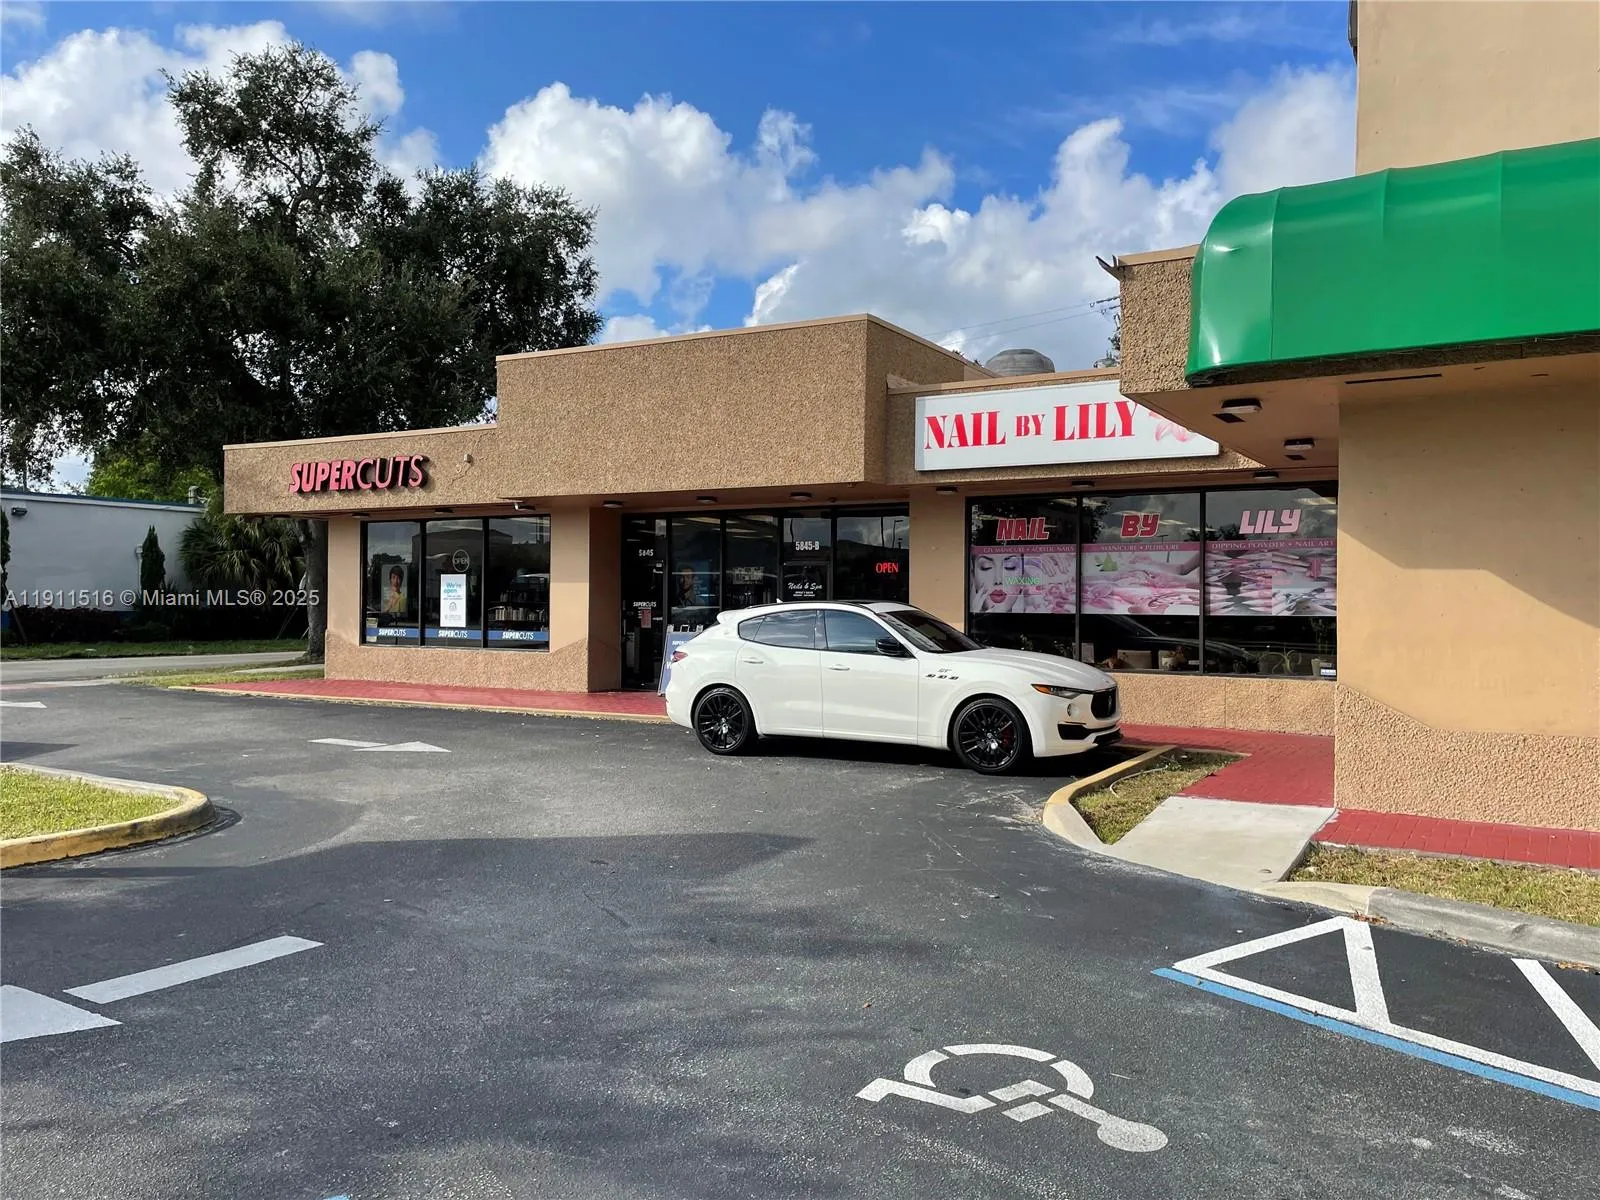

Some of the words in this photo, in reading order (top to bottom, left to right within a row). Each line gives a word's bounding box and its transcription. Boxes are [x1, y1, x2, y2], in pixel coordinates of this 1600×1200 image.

[925, 410, 1006, 450] NAIL
[1015, 414, 1045, 437] BY
[1053, 400, 1138, 442] LILY
[288, 454, 423, 493] SUPERCUTS
[996, 517, 1049, 541] NAIL
[1121, 512, 1160, 538] BY
[1239, 509, 1301, 534] LILY
[795, 541, 820, 551] 5845-B
[875, 562, 899, 574] OPEN
[1006, 576, 1041, 585] WAXING
[378, 628, 407, 637] SUPERCUTS
[438, 629, 468, 639] SUPERCUTS
[502, 631, 534, 640] SUPERCUTS
